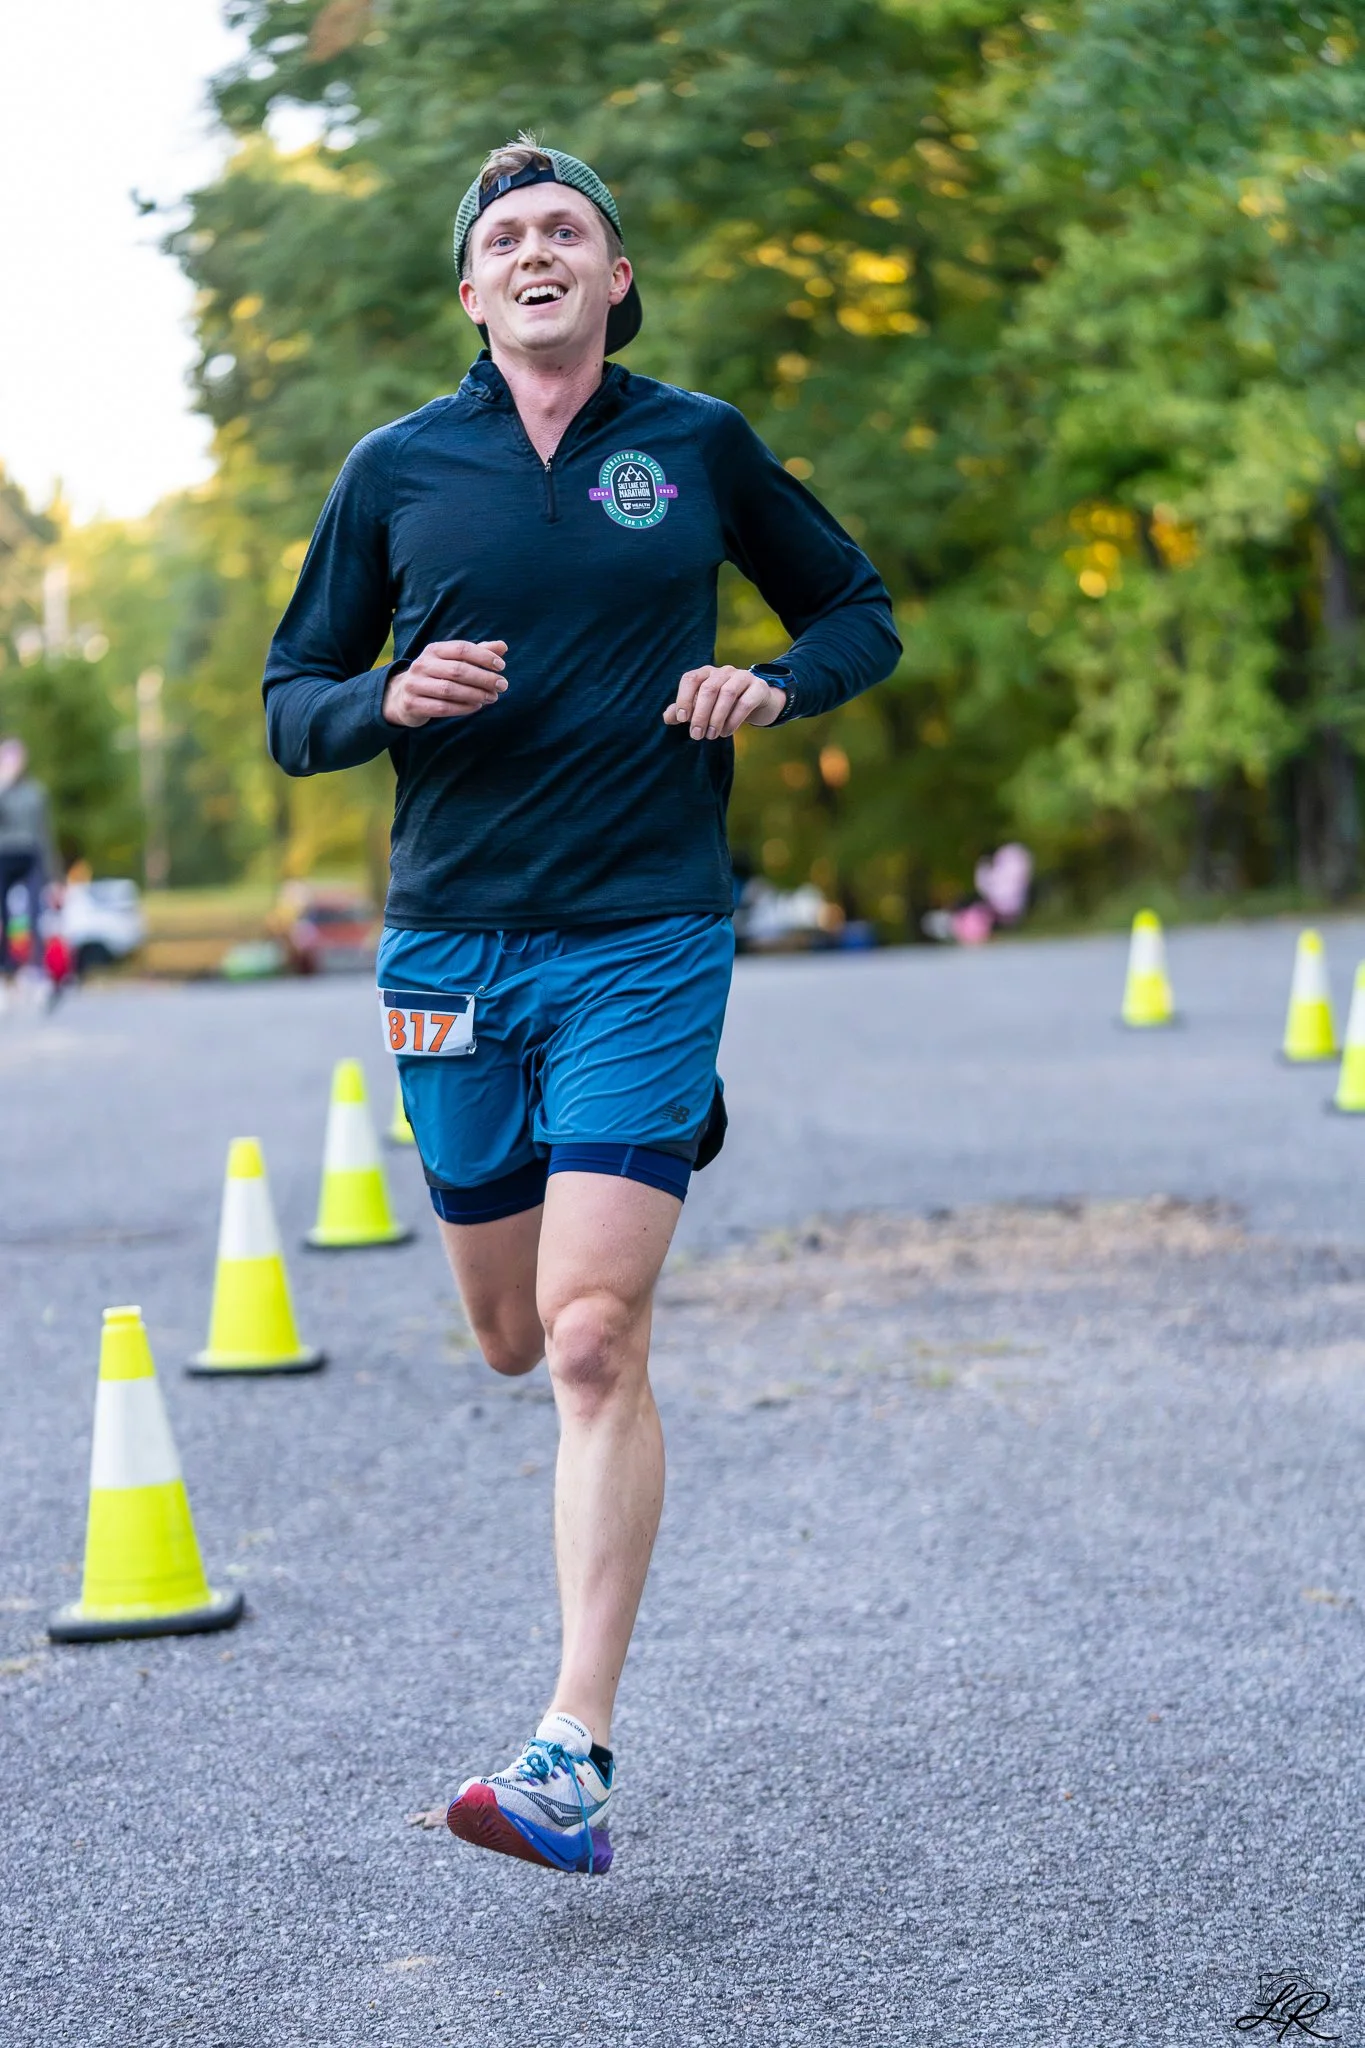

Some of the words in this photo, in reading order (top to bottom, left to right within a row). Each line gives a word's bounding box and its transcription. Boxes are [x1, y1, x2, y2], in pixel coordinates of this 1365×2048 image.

[602, 453, 634, 484] CELEBRATING
[617, 482, 628, 490] SALT
[618, 488, 651, 498] MARATHON
[388, 1009, 458, 1052] 817
